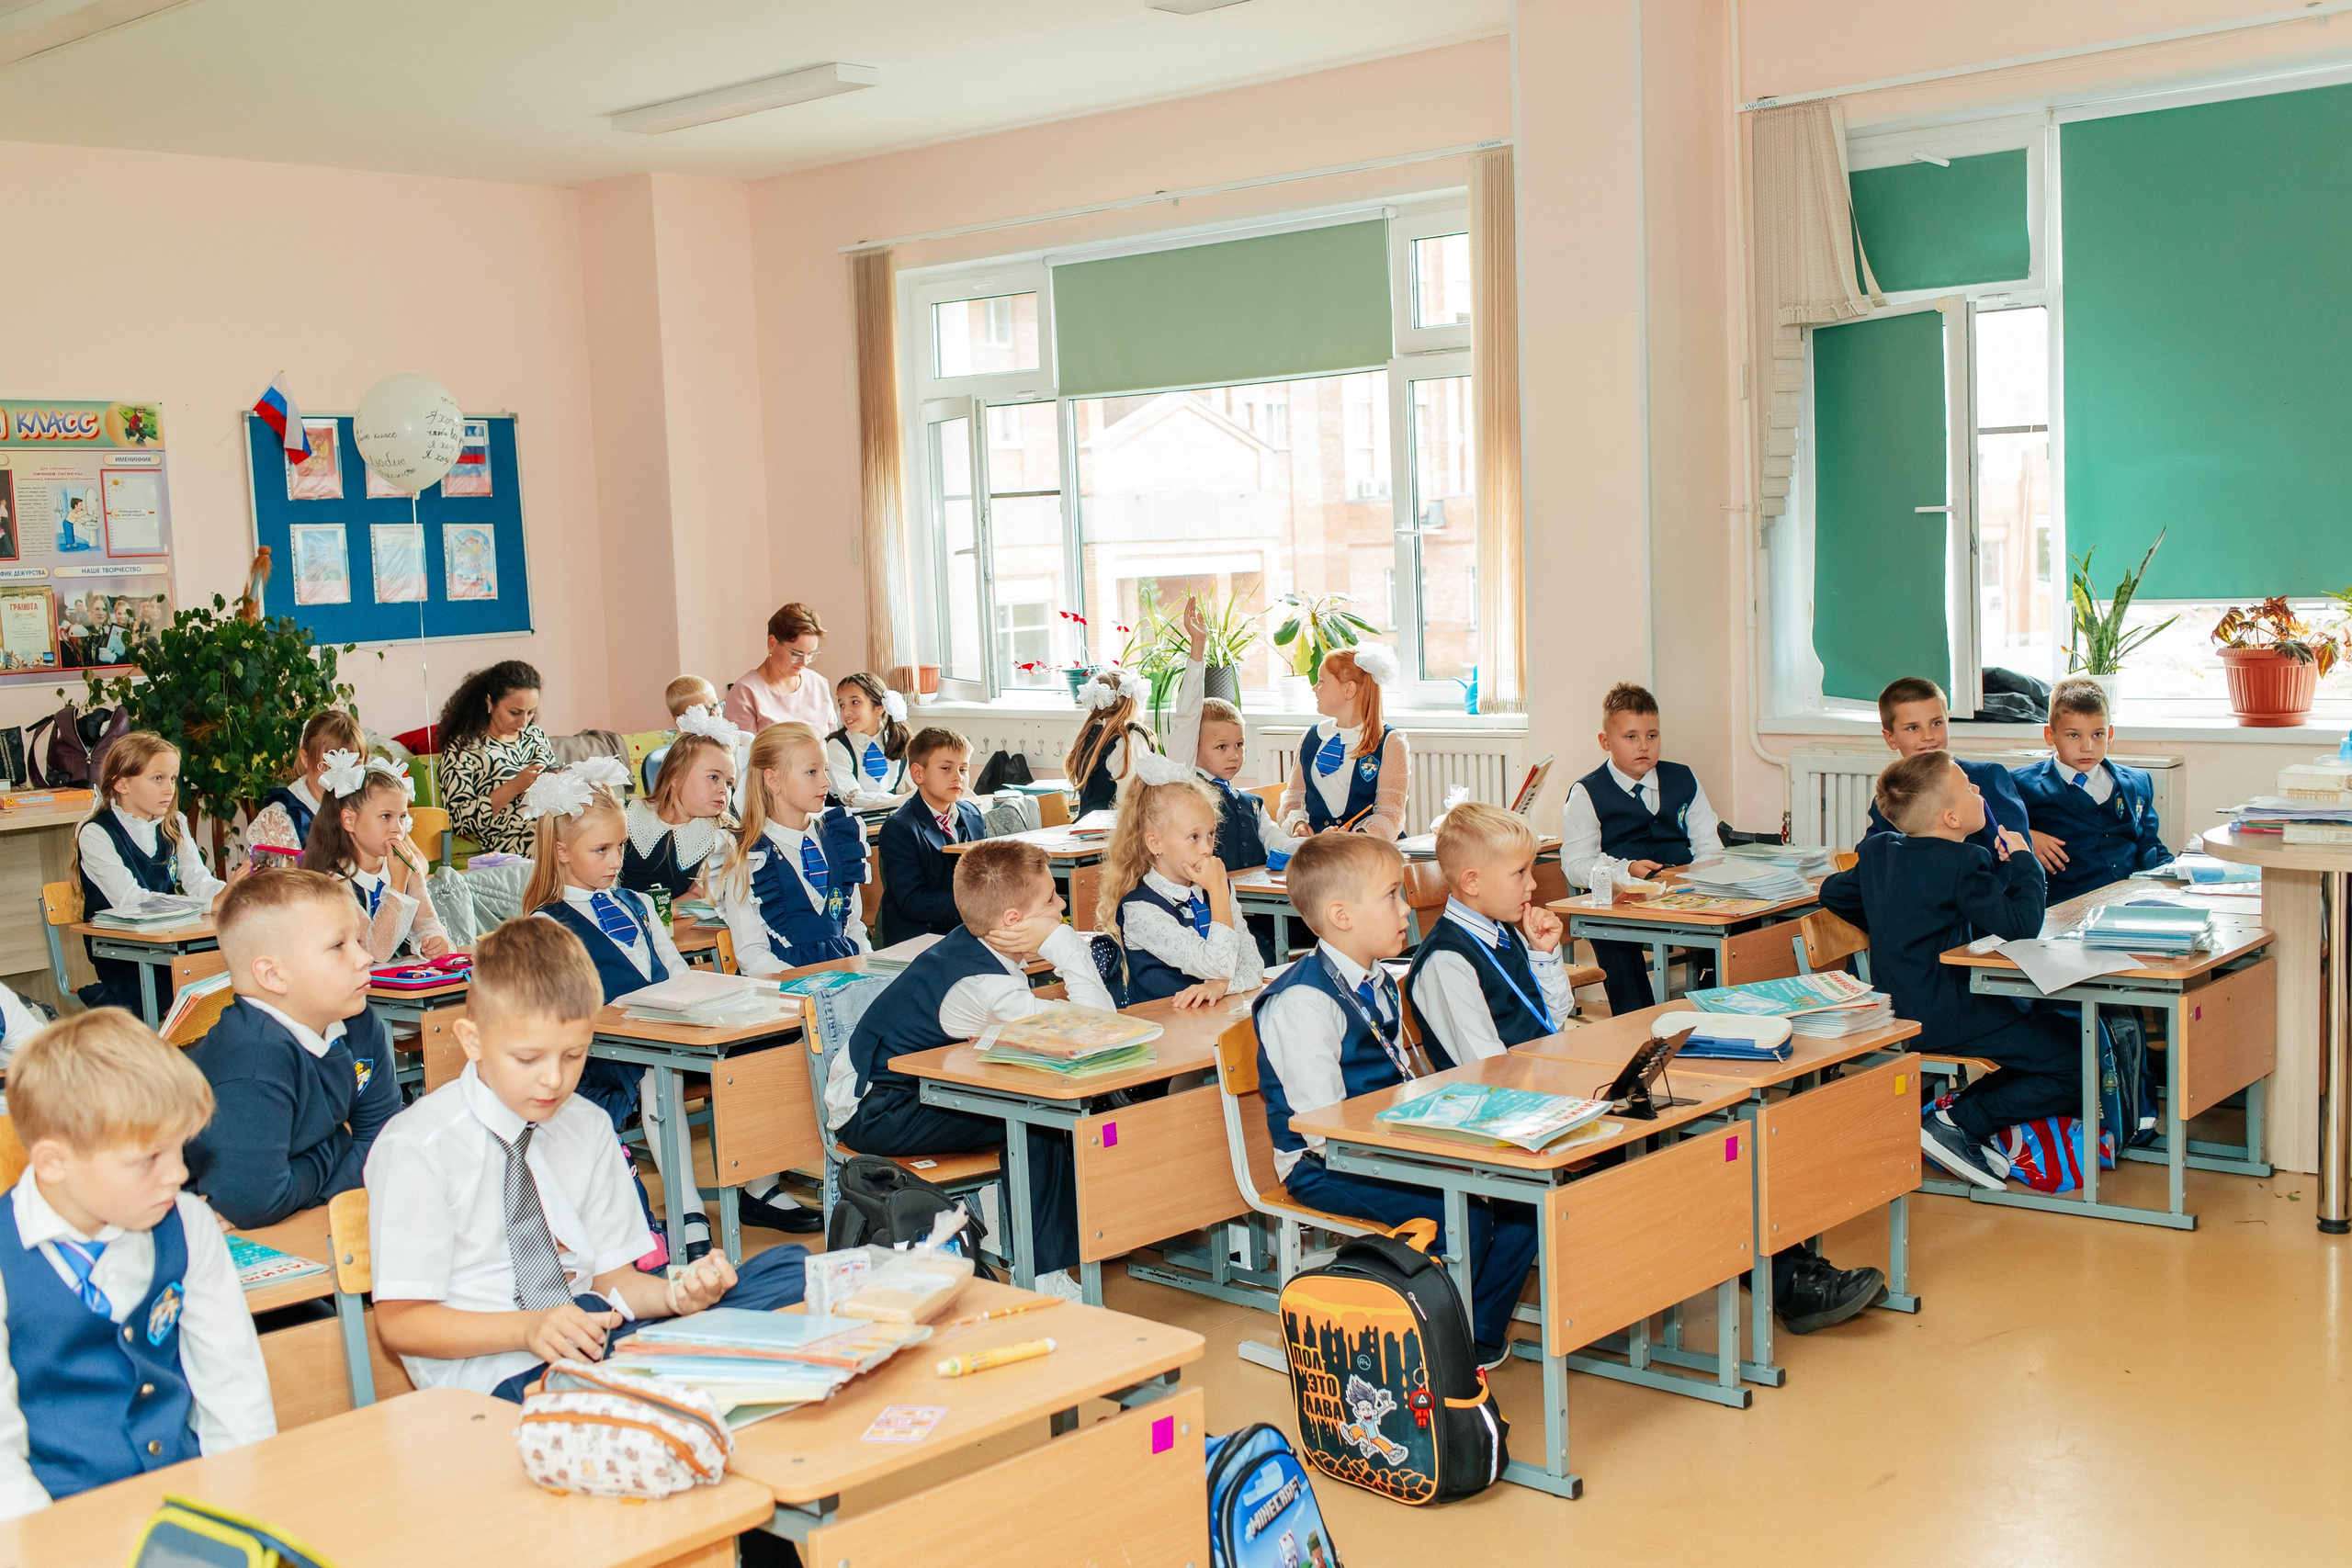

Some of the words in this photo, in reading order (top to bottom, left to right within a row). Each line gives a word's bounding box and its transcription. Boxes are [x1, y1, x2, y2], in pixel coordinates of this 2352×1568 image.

[16, 410, 96, 437] КЛАСС
[102, 566, 141, 574] ТВОРЧЕСТВО
[9, 603, 39, 612] ГРАМОТА
[1293, 1343, 1324, 1371] ПОЛ
[1307, 1372, 1339, 1397] ЭТО
[1305, 1393, 1341, 1421] ЛАВА
[1249, 1474, 1302, 1539] MINECRAFT
